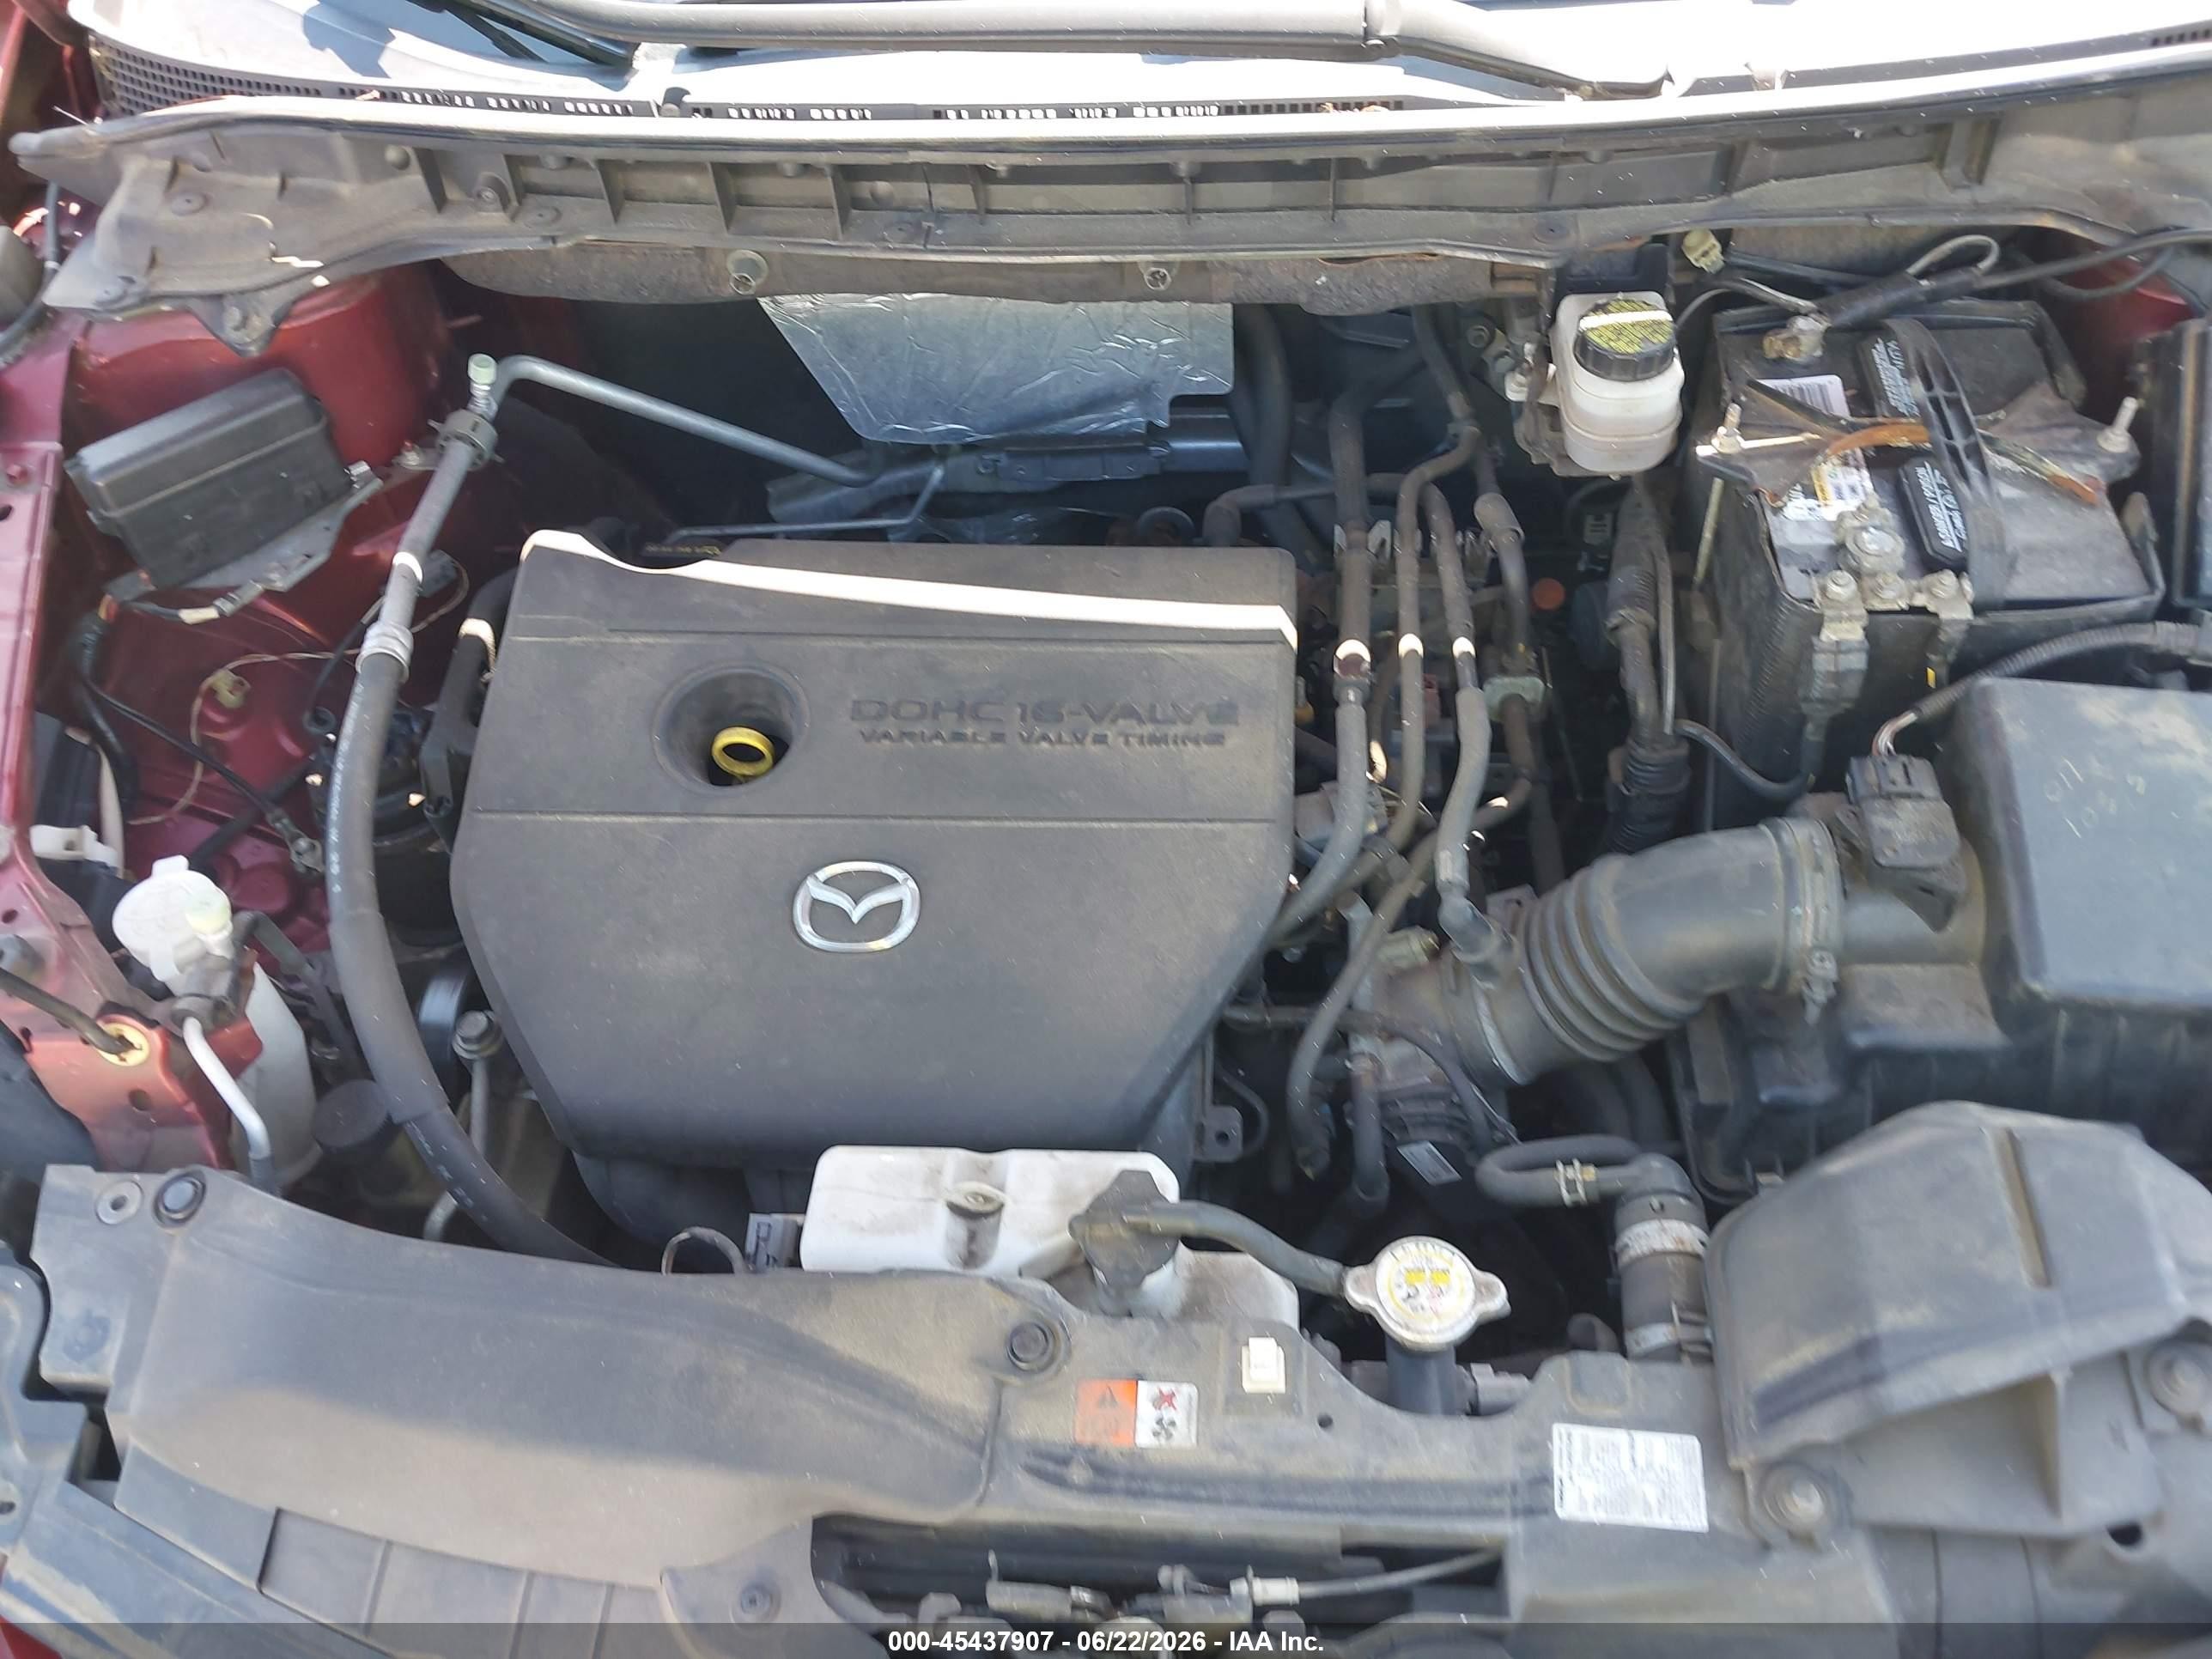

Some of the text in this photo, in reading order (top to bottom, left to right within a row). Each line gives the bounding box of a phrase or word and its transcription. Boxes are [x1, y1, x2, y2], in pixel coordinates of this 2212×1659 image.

[850, 699, 1005, 723] DOHC
[860, 728, 1225, 747] VARIABLE VALVE TIMING
